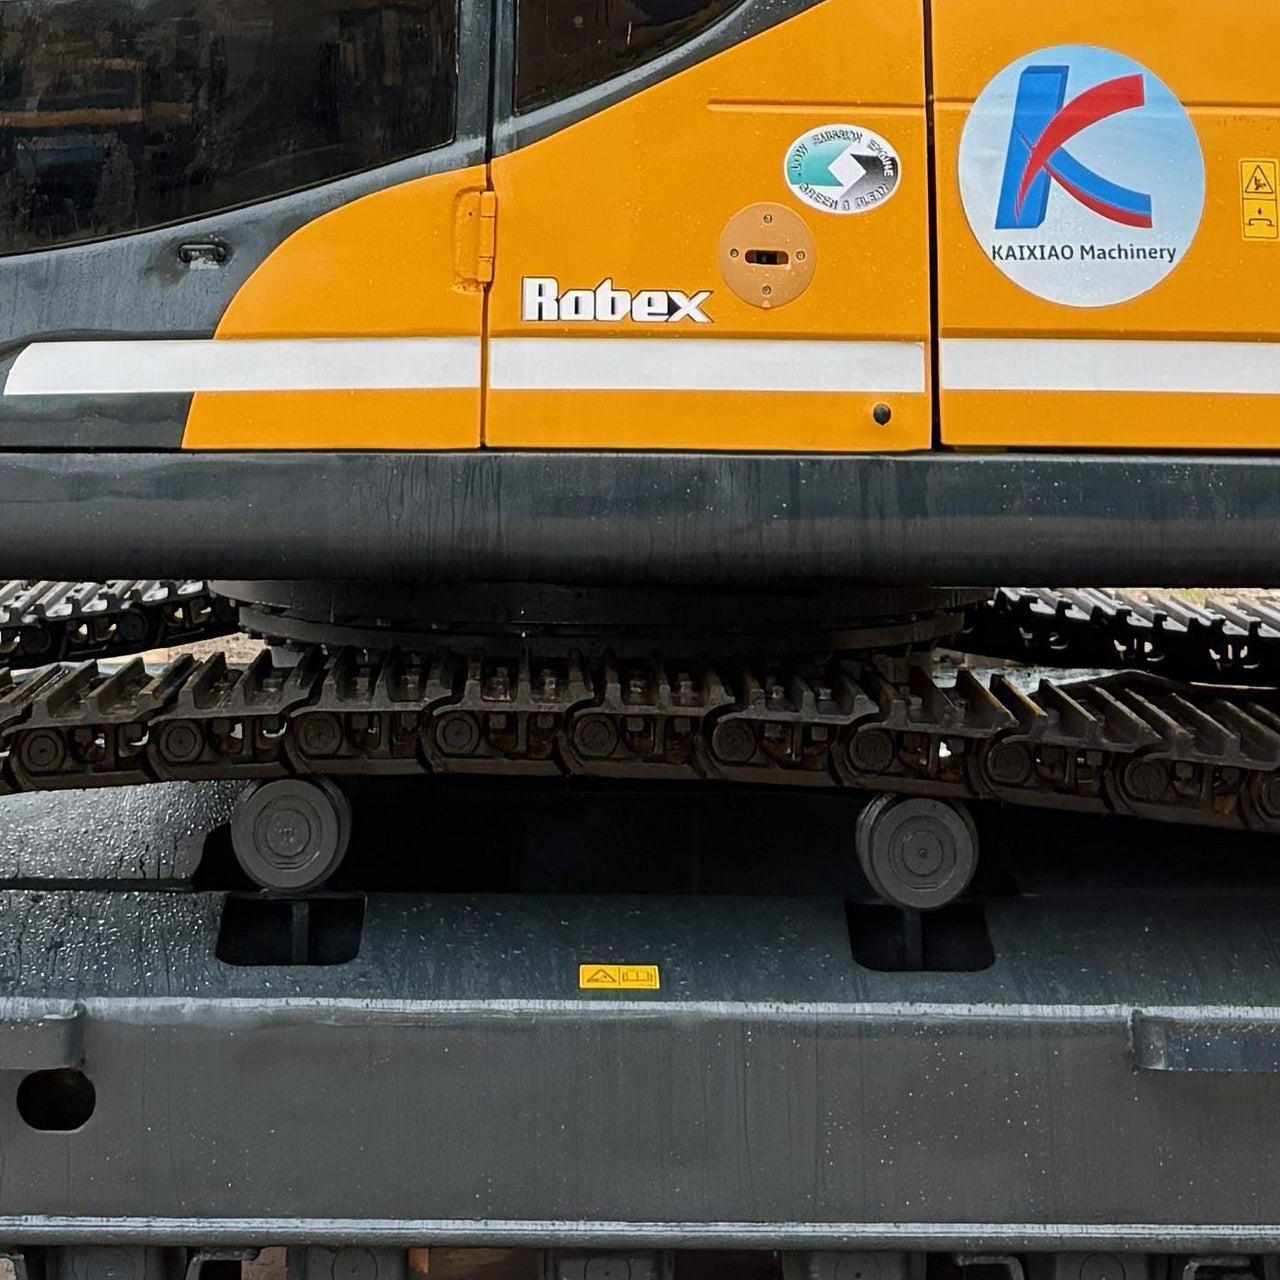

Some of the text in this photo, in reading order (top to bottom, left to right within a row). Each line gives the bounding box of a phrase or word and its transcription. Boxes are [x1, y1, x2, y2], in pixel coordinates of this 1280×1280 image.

[991, 243, 1177, 263] KAIXIAO Machinery
[521, 276, 715, 324] Robex
